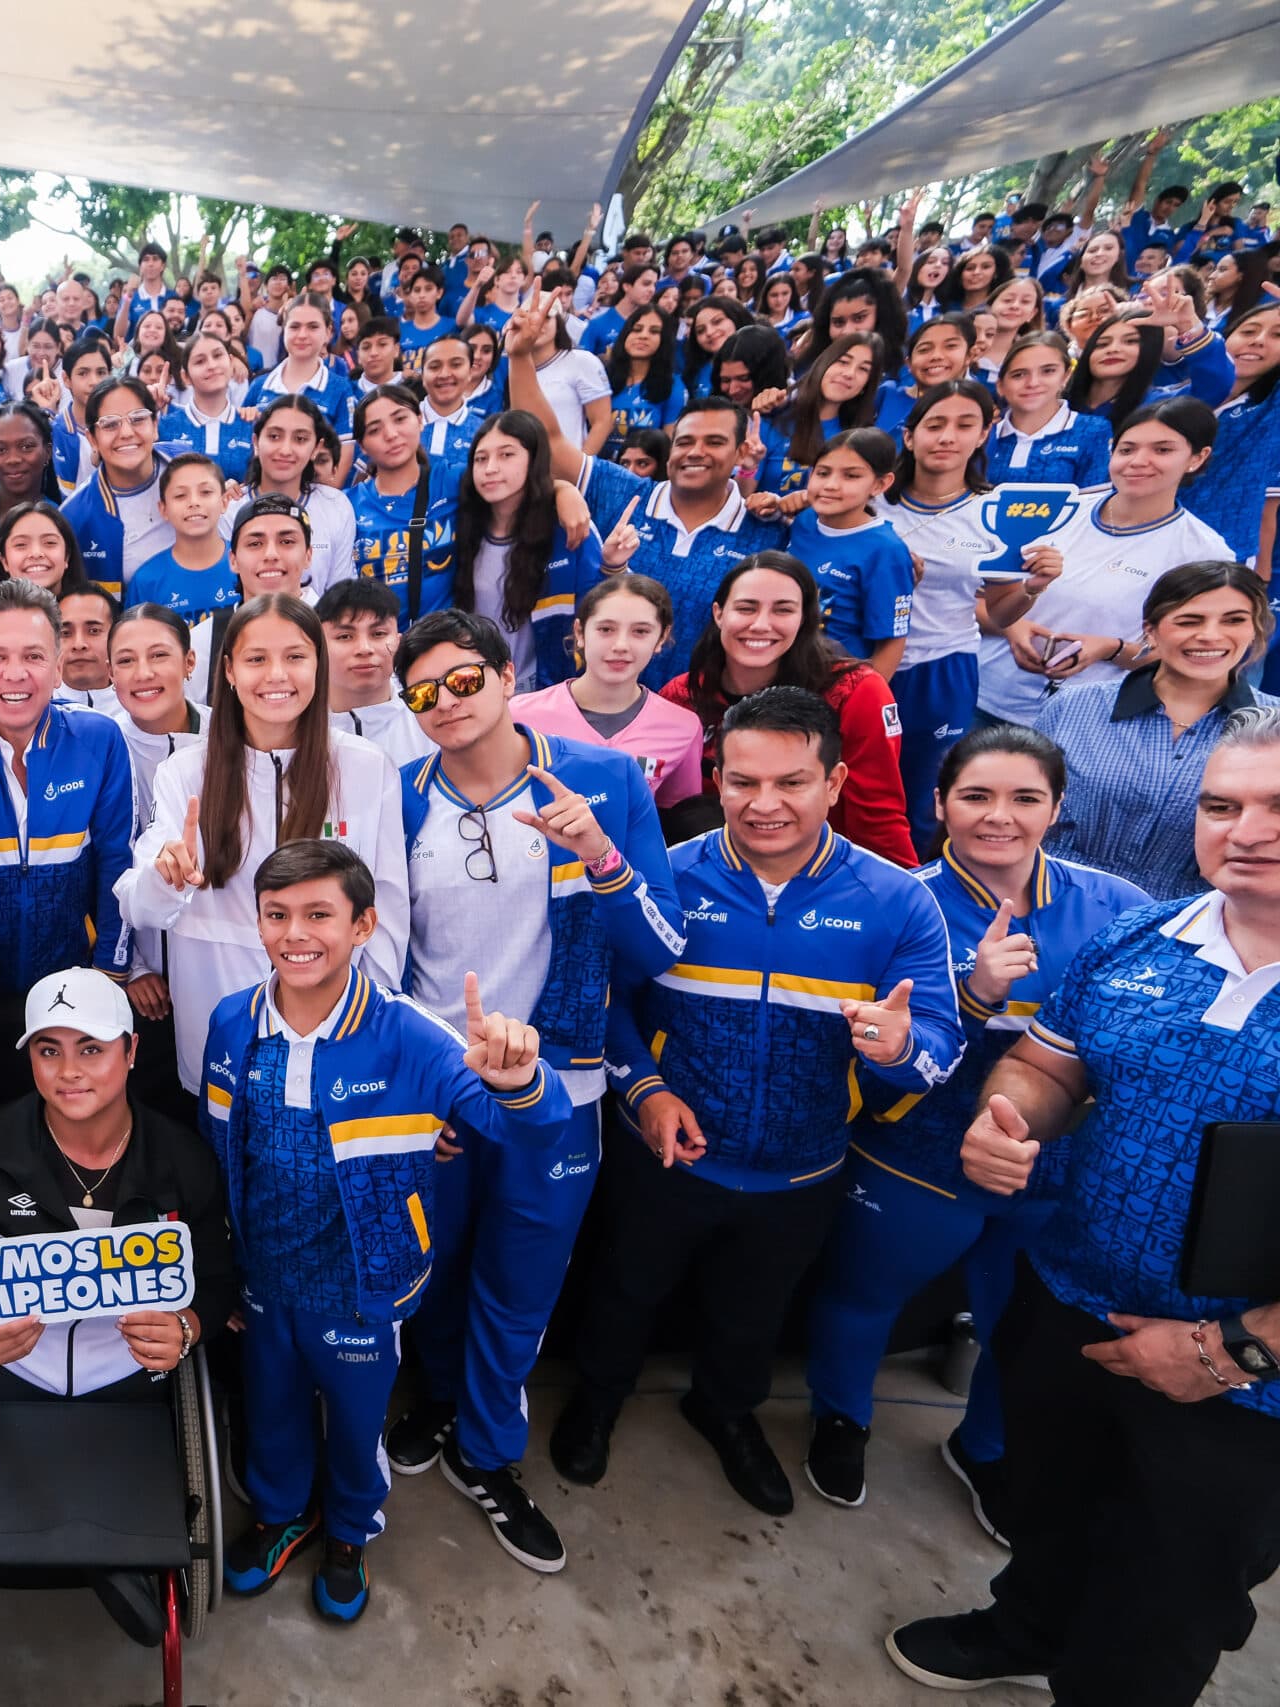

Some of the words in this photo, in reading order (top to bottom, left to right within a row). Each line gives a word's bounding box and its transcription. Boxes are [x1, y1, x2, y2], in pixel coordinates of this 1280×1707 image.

[1006, 503, 1050, 517] #24
[961, 541, 982, 549] CODE
[1125, 566, 1148, 578] CODE
[60, 780, 85, 794] CODE
[585, 792, 608, 806] ODE
[825, 917, 862, 931] CODE
[1109, 977, 1164, 999] sporelli
[352, 1080, 386, 1095] CODE
[10, 1209, 37, 1217] umbro
[344, 1337, 376, 1345] CODE
